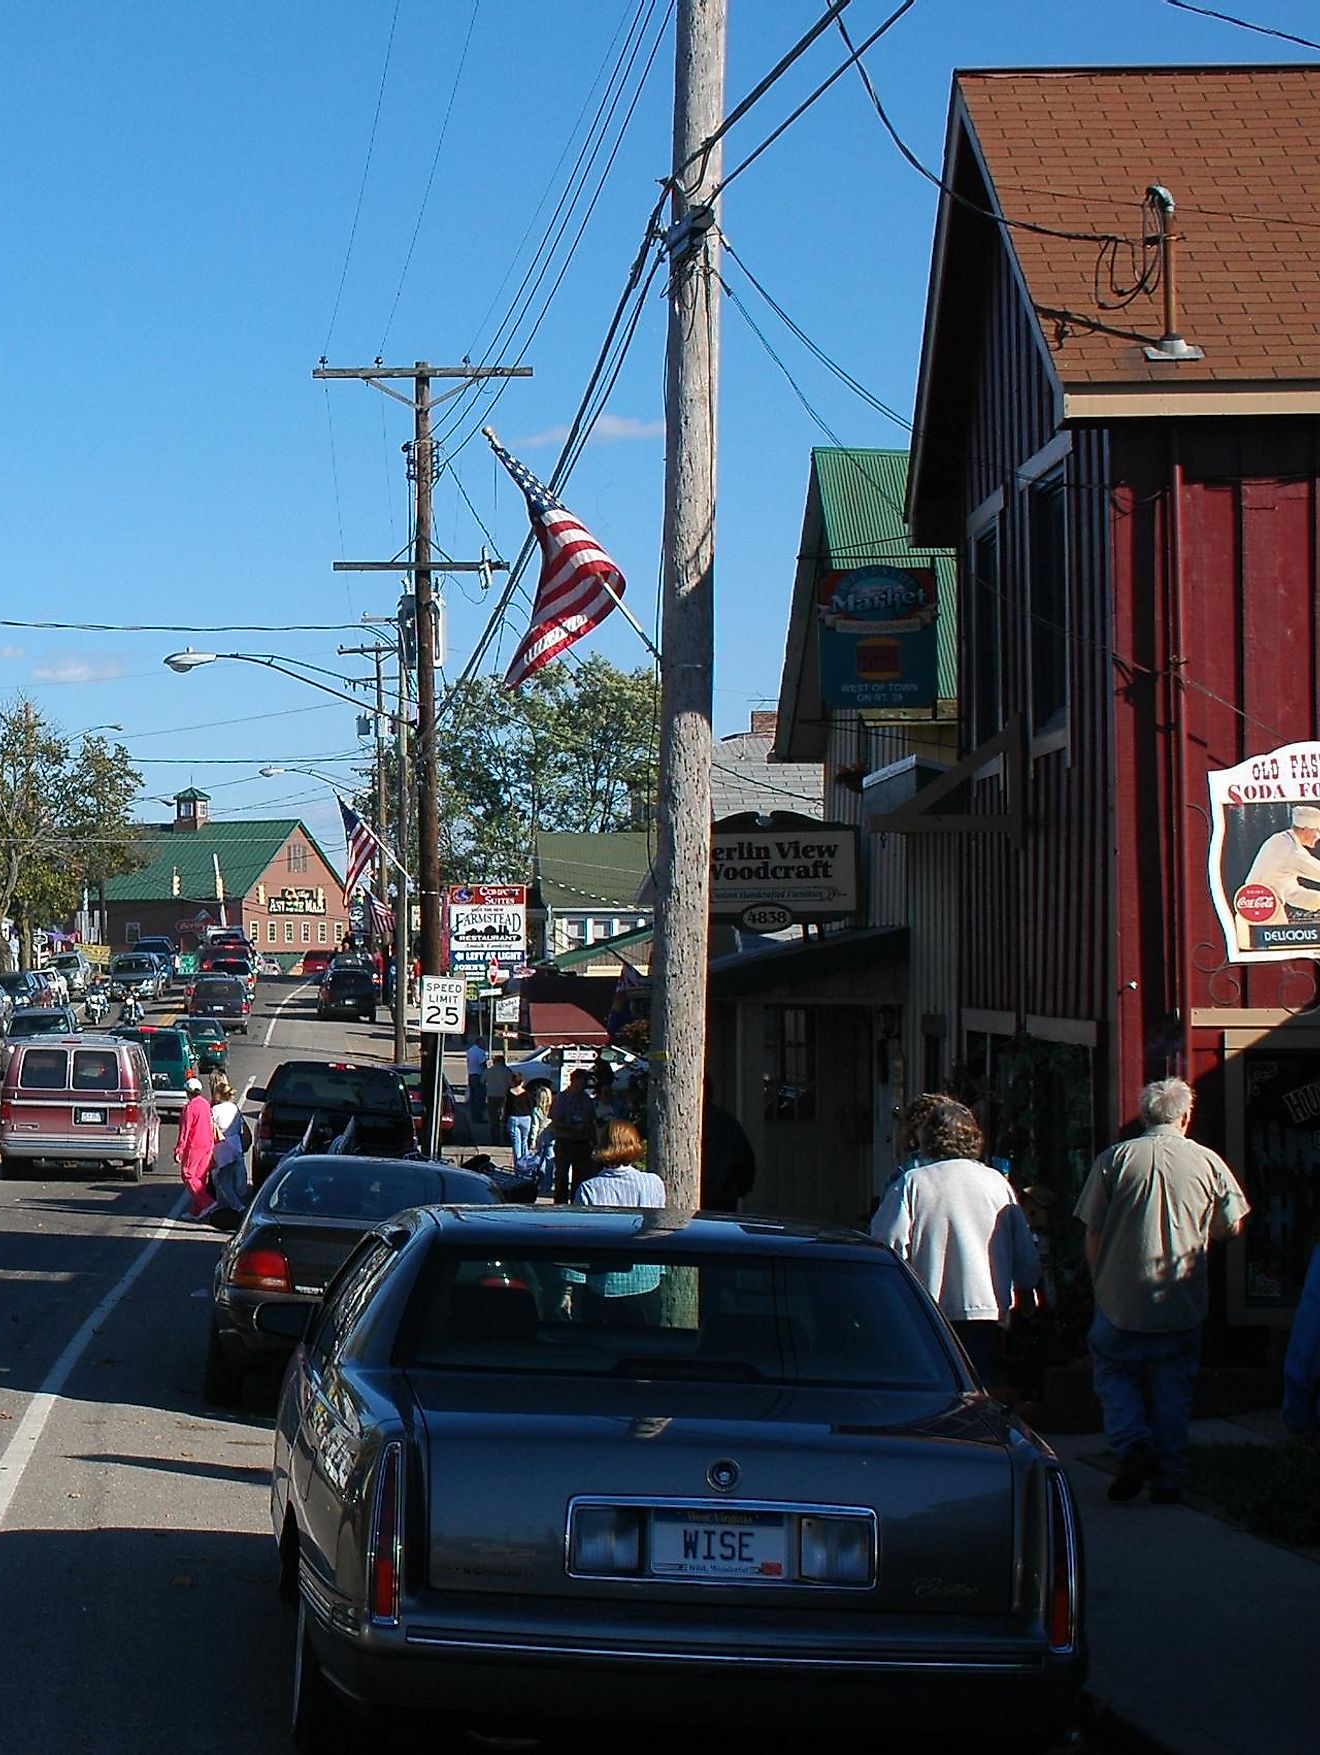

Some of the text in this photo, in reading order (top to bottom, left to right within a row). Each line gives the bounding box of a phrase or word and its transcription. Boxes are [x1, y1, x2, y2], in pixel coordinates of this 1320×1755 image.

[1252, 754, 1320, 780] OLD FAS
[1228, 784, 1285, 808] SODA
[711, 840, 837, 860] erlin View
[480, 886, 520, 896] COMFOT
[451, 912, 522, 933] FARMSTEAD
[747, 910, 787, 924] 4838
[1264, 929, 1318, 942] DELICIOUS
[466, 952, 485, 960] LEFT
[498, 952, 522, 961] LIGHT
[426, 982, 462, 993] SPEED
[429, 995, 458, 1003] LIMIT
[426, 1006, 459, 1026] 25
[683, 1529, 755, 1561] WISE
